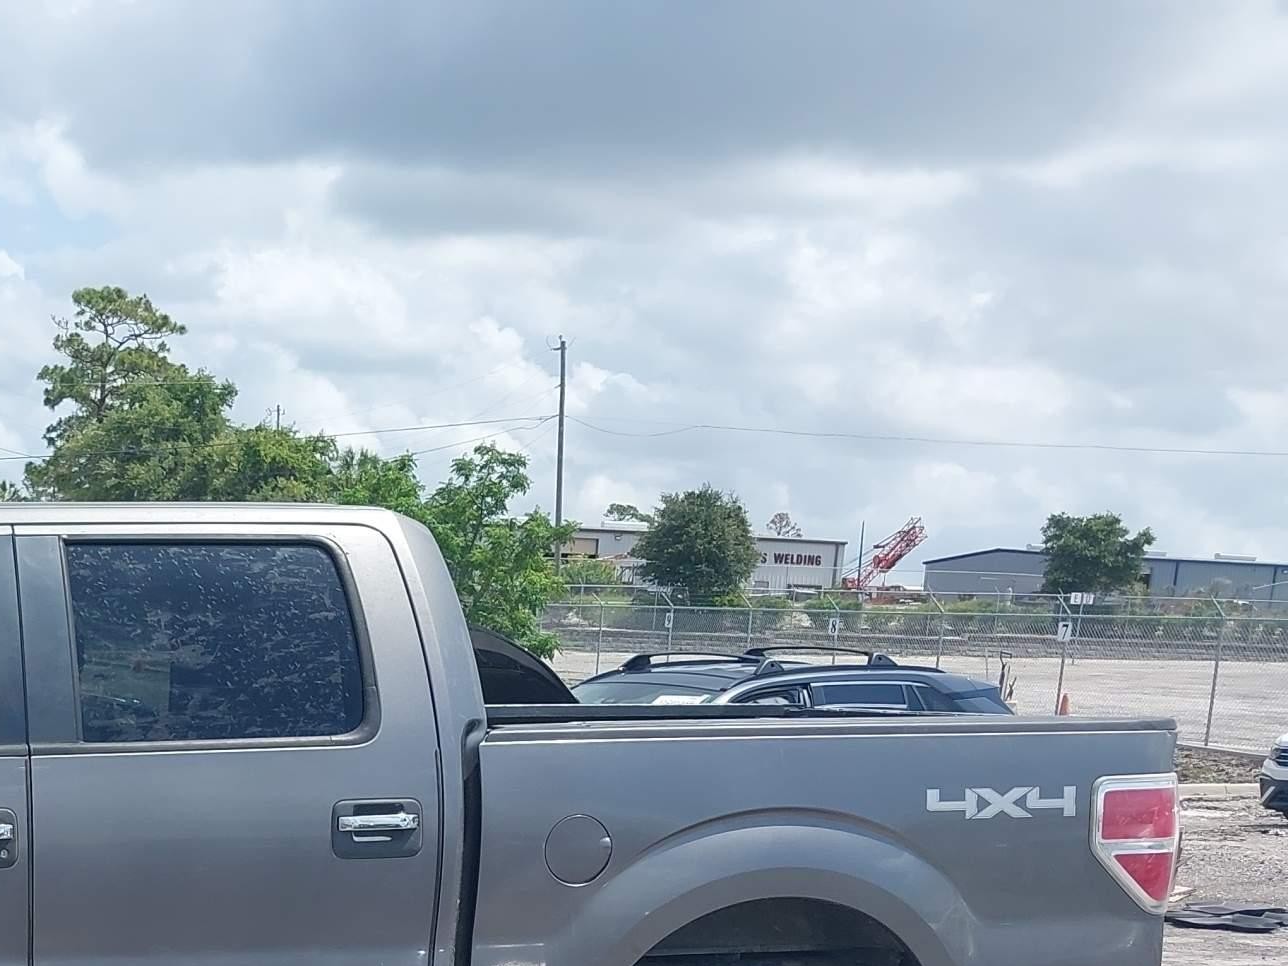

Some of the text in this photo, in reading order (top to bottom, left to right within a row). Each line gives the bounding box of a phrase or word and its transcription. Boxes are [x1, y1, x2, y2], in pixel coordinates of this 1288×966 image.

[774, 552, 822, 567] WELDING
[830, 619, 838, 634] 8
[1062, 623, 1070, 641] 7
[926, 785, 1077, 820] 4X4
